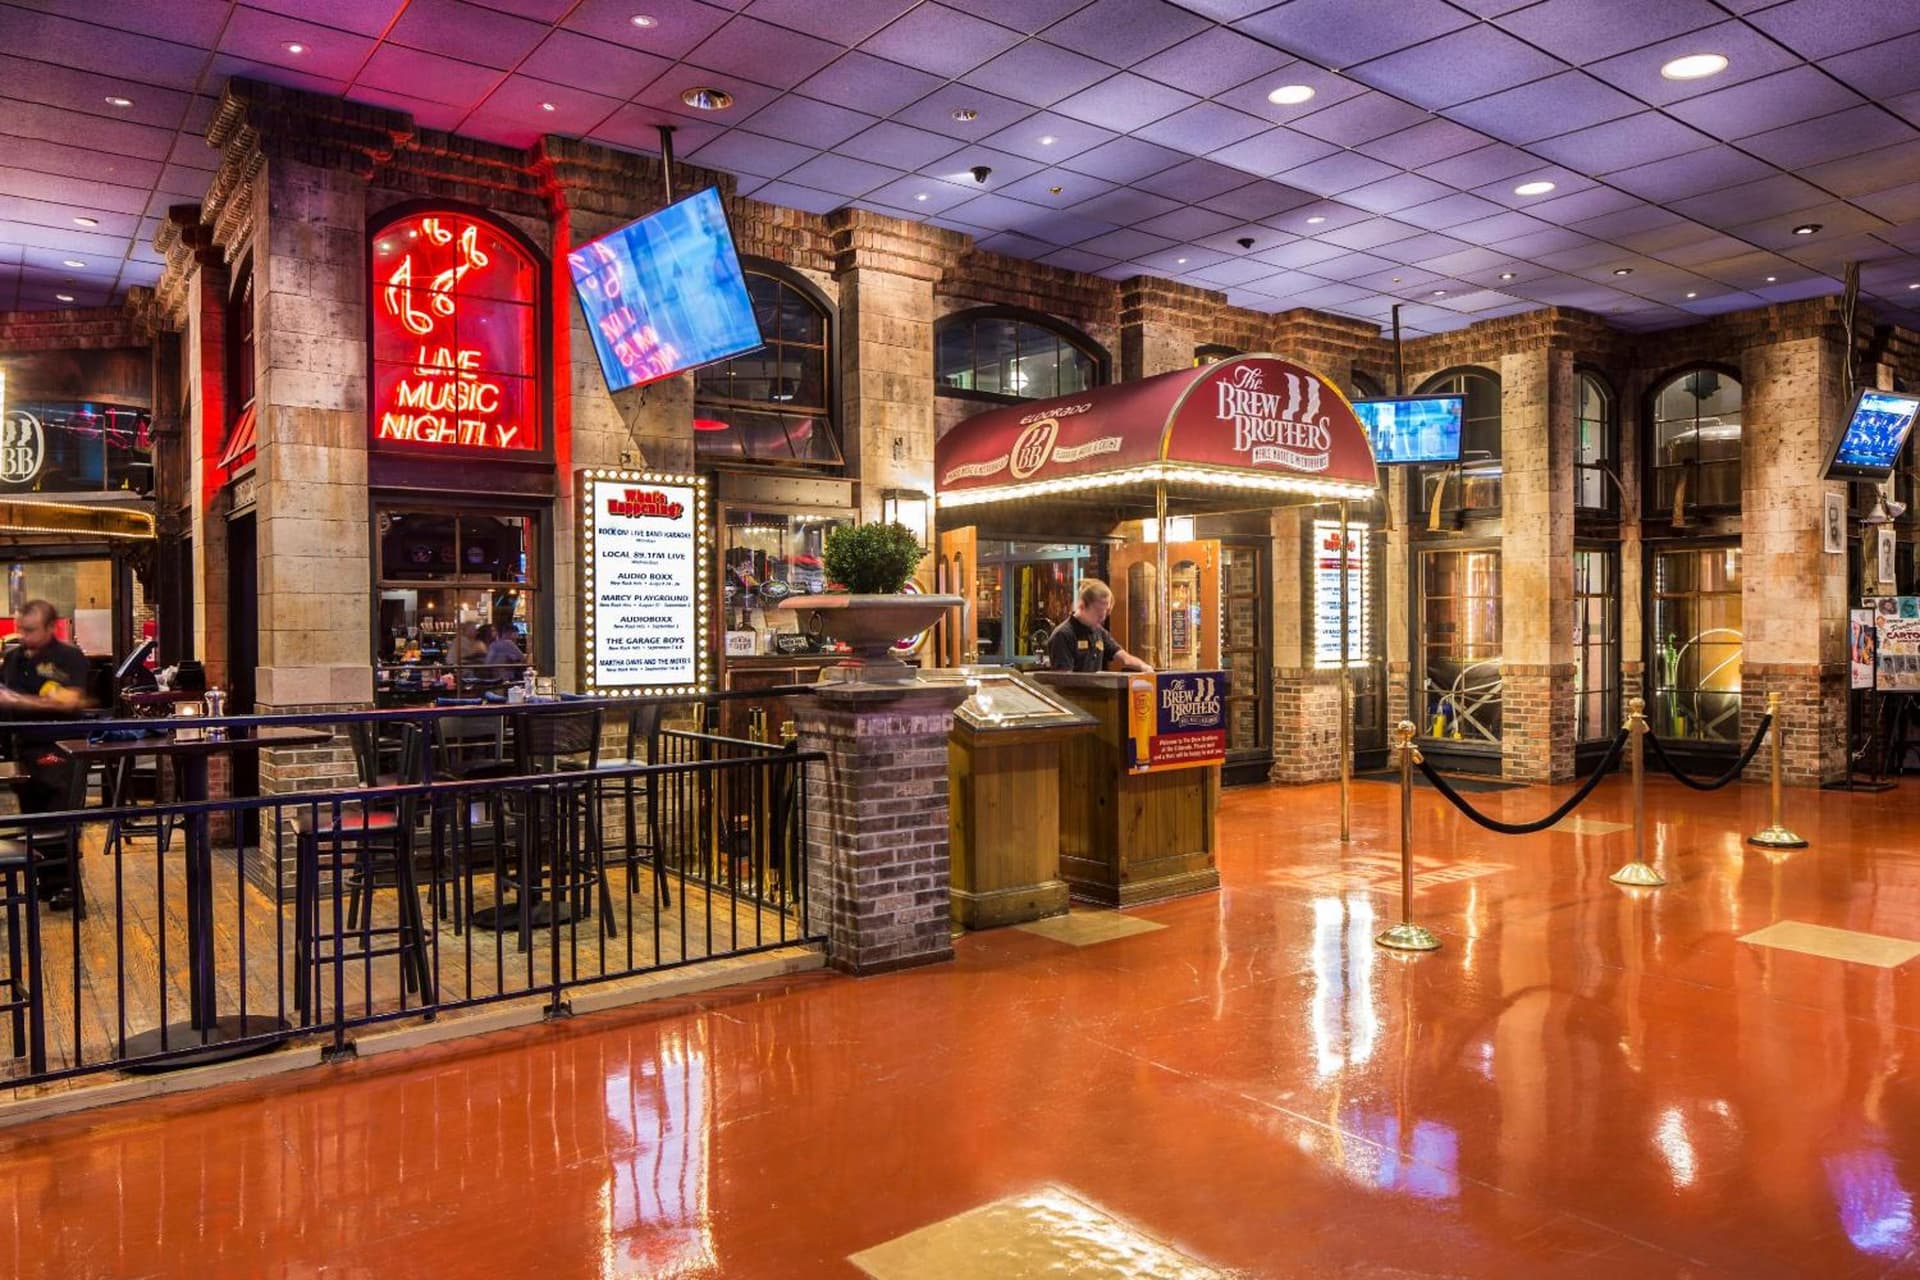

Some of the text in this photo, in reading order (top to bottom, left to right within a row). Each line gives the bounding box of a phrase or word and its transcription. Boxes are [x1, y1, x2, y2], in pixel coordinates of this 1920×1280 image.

[415, 346, 481, 379] LIVE
[1234, 365, 1264, 391] The
[397, 380, 500, 412] MUSIC
[1216, 377, 1280, 420] BREW
[378, 412, 518, 448] NIGHTLY
[1233, 416, 1331, 455] BROTHERS
[1018, 445, 1043, 468] BB
[624, 489, 667, 503] What's
[626, 637, 661, 645] GARAGE
[1161, 688, 1194, 709] BREW
[1170, 695, 1220, 723] BROTHERS
